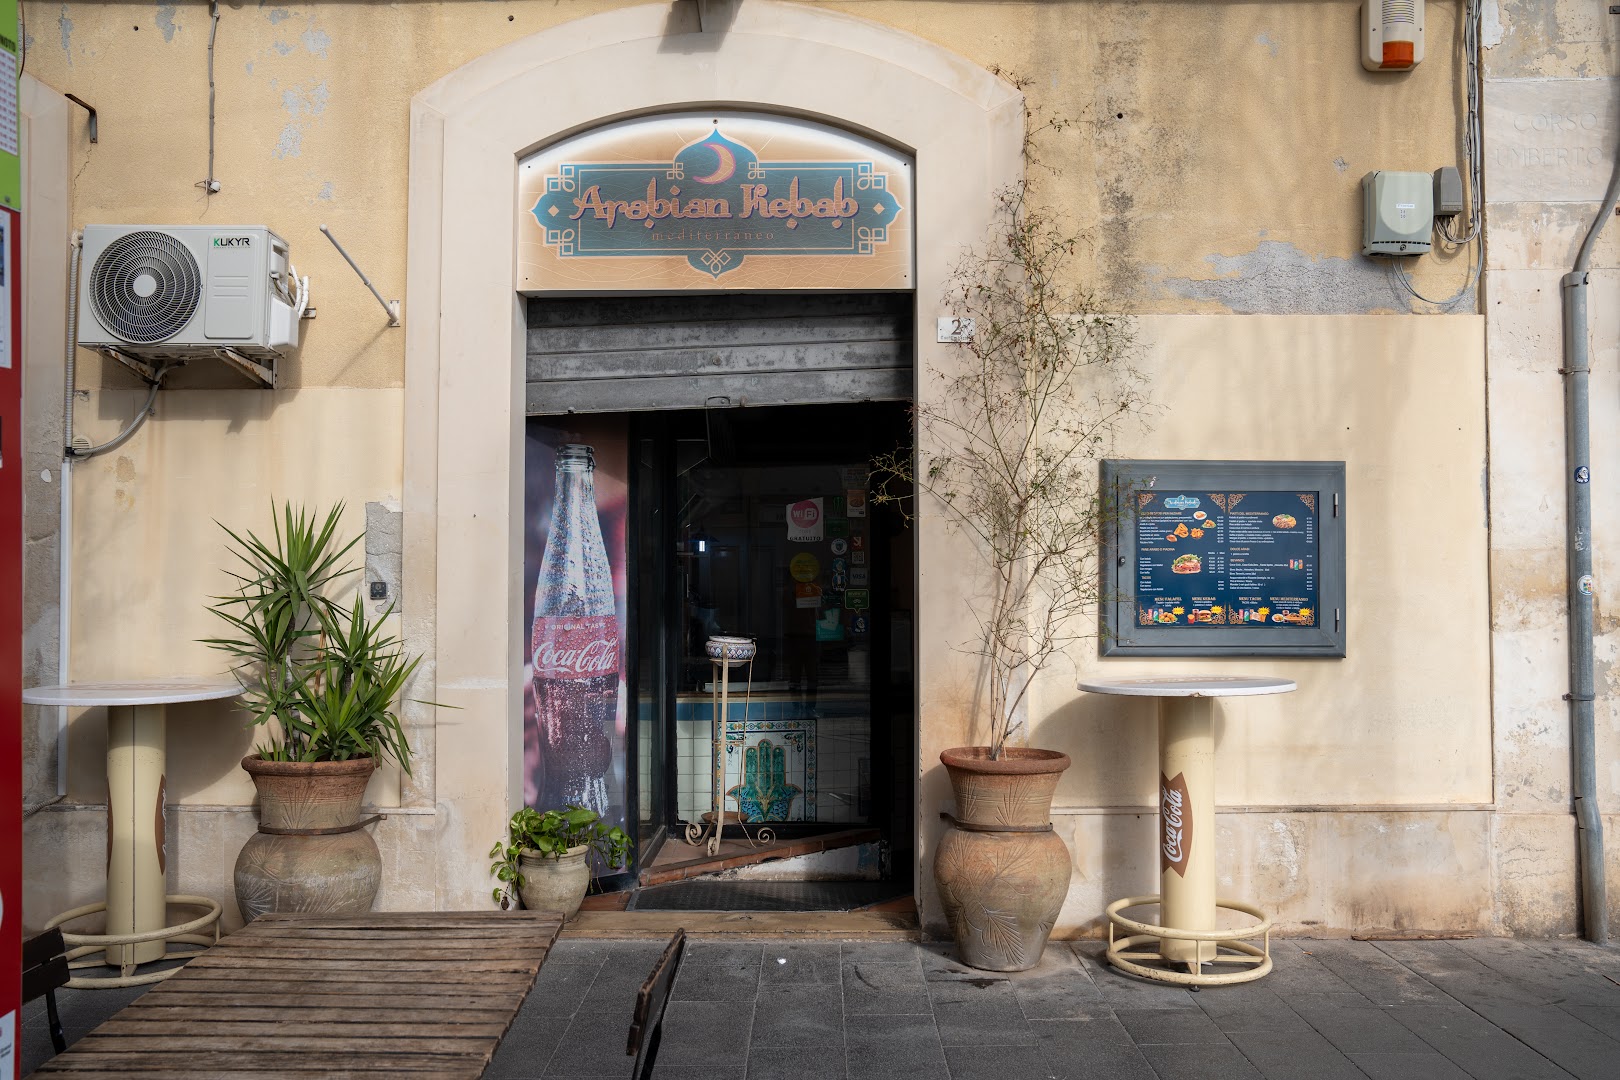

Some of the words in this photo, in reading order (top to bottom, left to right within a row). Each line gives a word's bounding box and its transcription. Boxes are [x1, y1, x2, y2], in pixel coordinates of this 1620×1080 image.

[1513, 112, 1598, 132] CORSO
[1496, 146, 1603, 168] UMBERTO
[570, 177, 732, 229] Arabian
[739, 177, 860, 229] Kebab
[213, 237, 250, 246] KUKYR
[651, 230, 775, 240] mediterraneo
[550, 623, 585, 631] ORIGINAL
